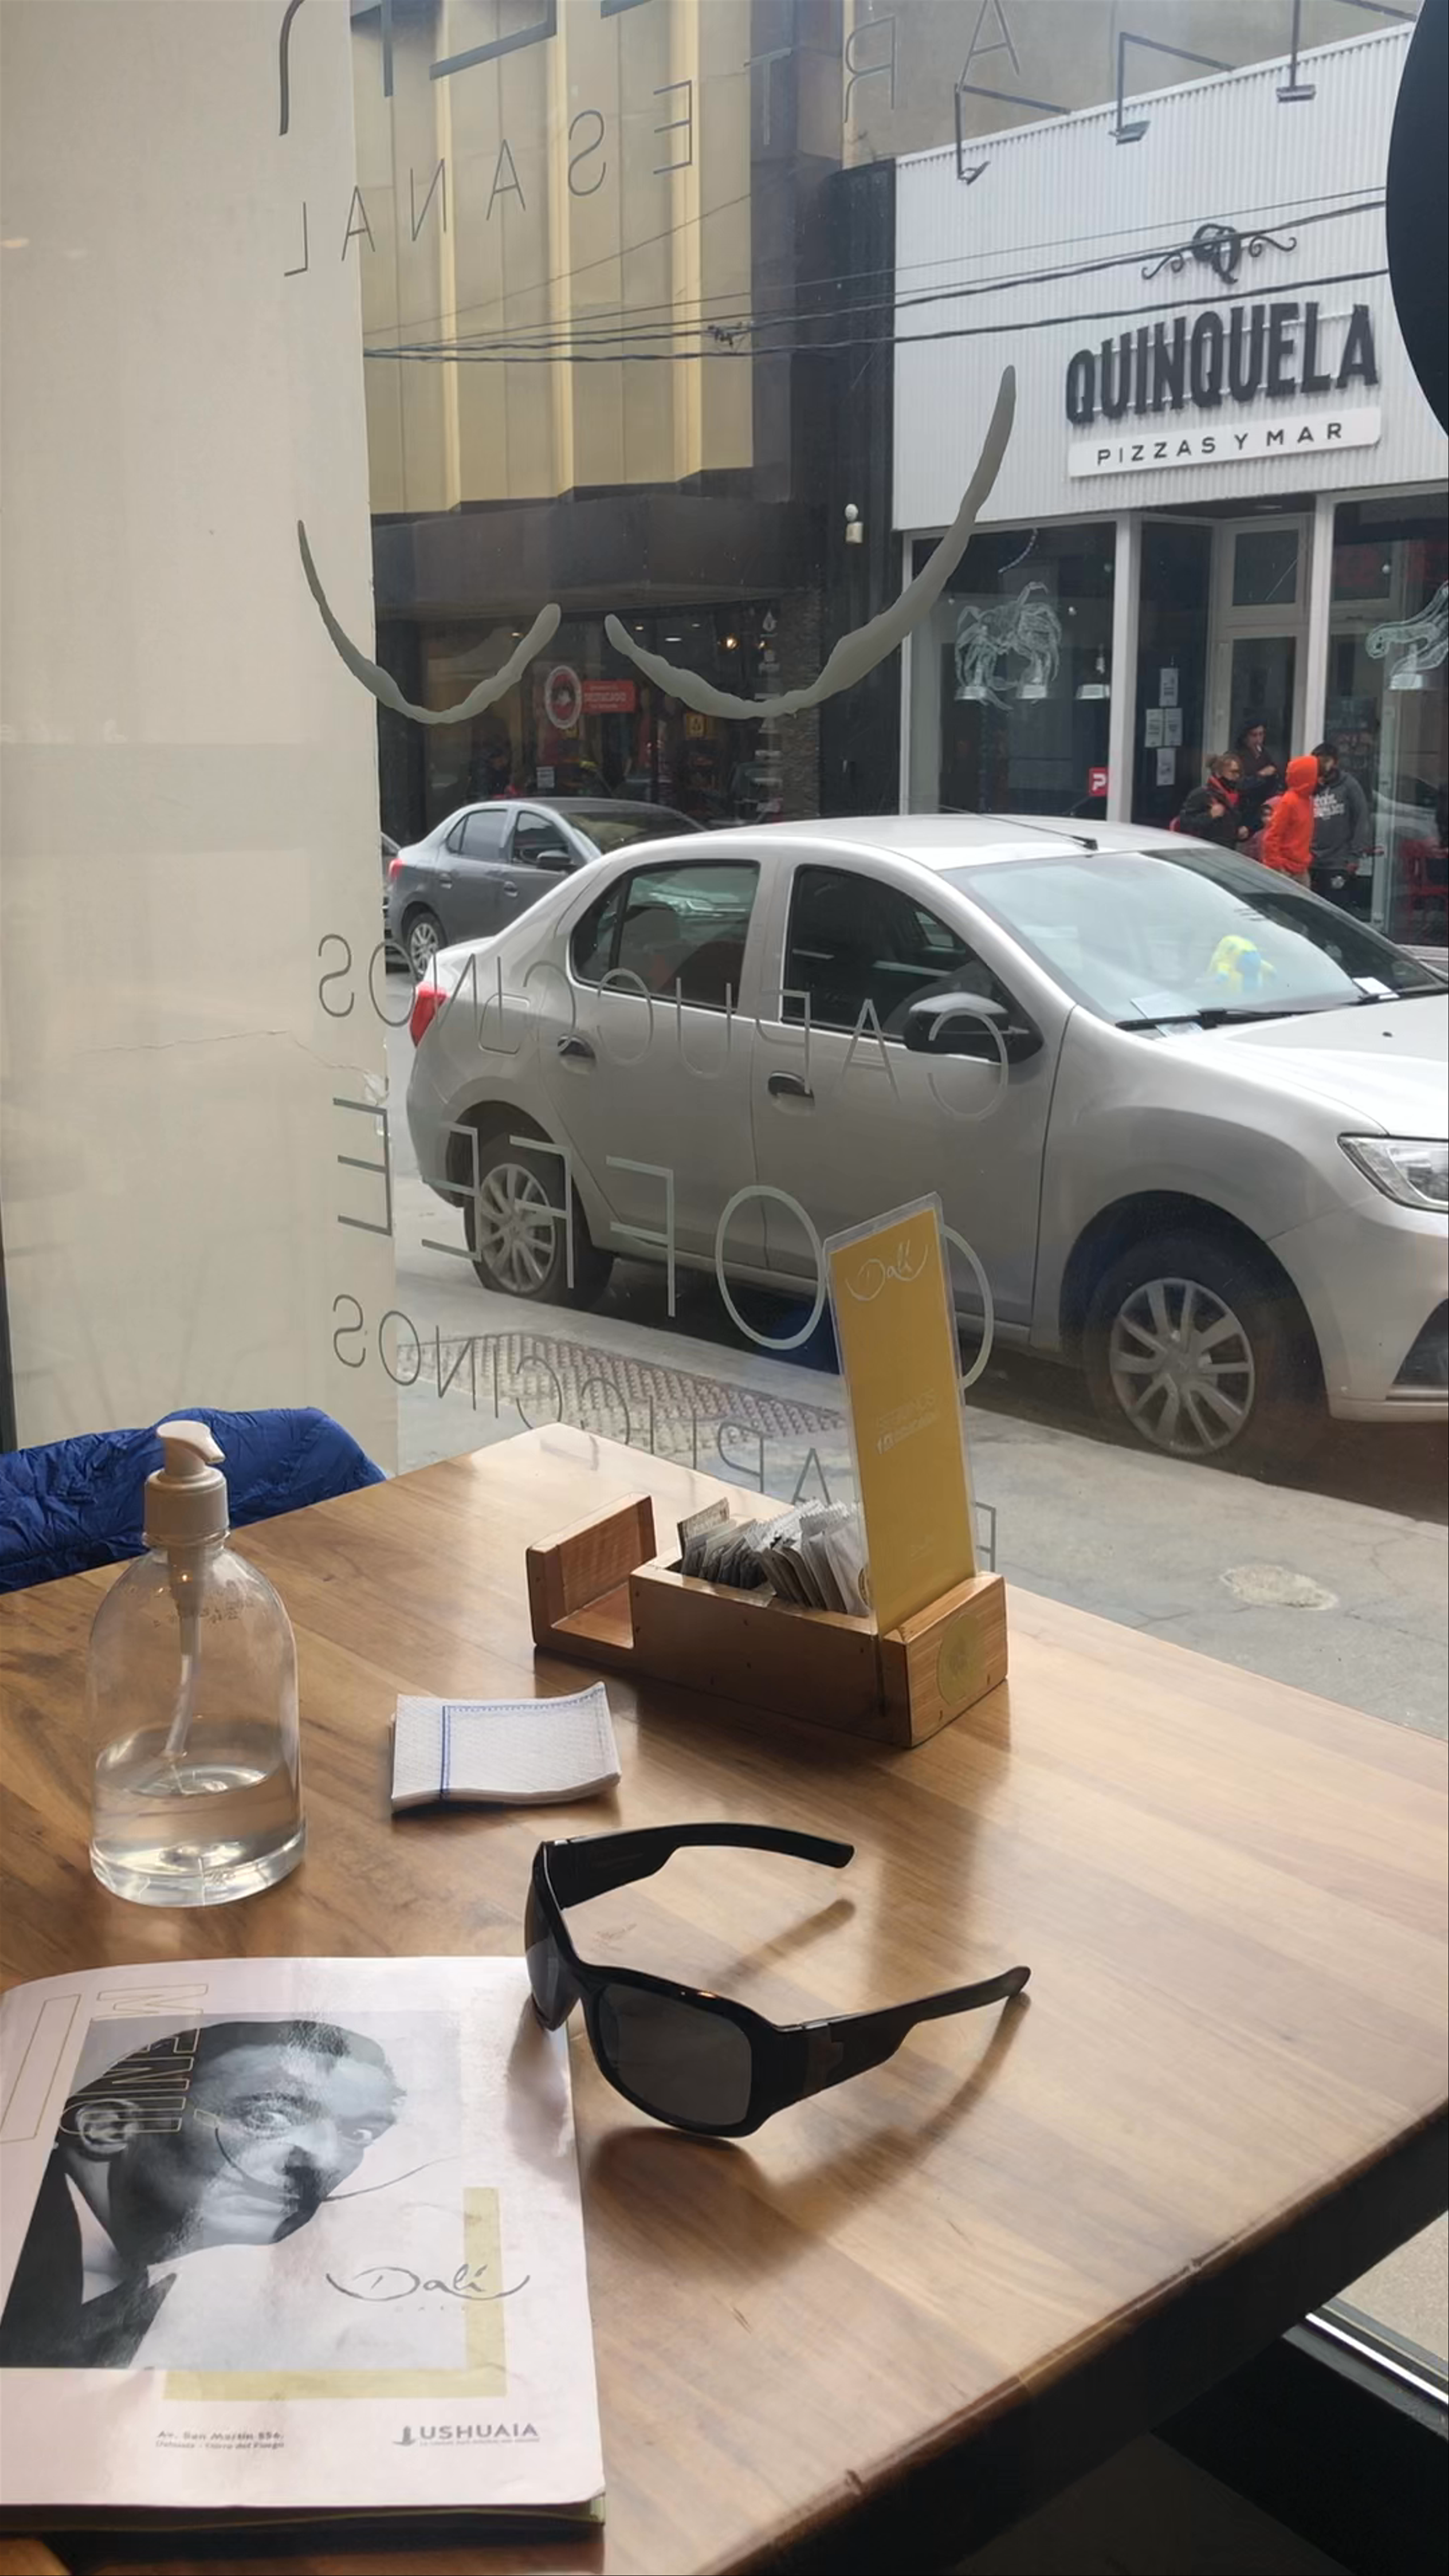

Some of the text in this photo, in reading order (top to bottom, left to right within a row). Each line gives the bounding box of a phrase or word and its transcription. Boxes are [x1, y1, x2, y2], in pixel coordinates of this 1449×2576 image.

[1066, 302, 1378, 423] QUINQUELA
[1097, 423, 1343, 466] PIZZAS Y MAR
[326, 2263, 530, 2301] Dalí
[420, 2423, 538, 2440] USHUAIA
